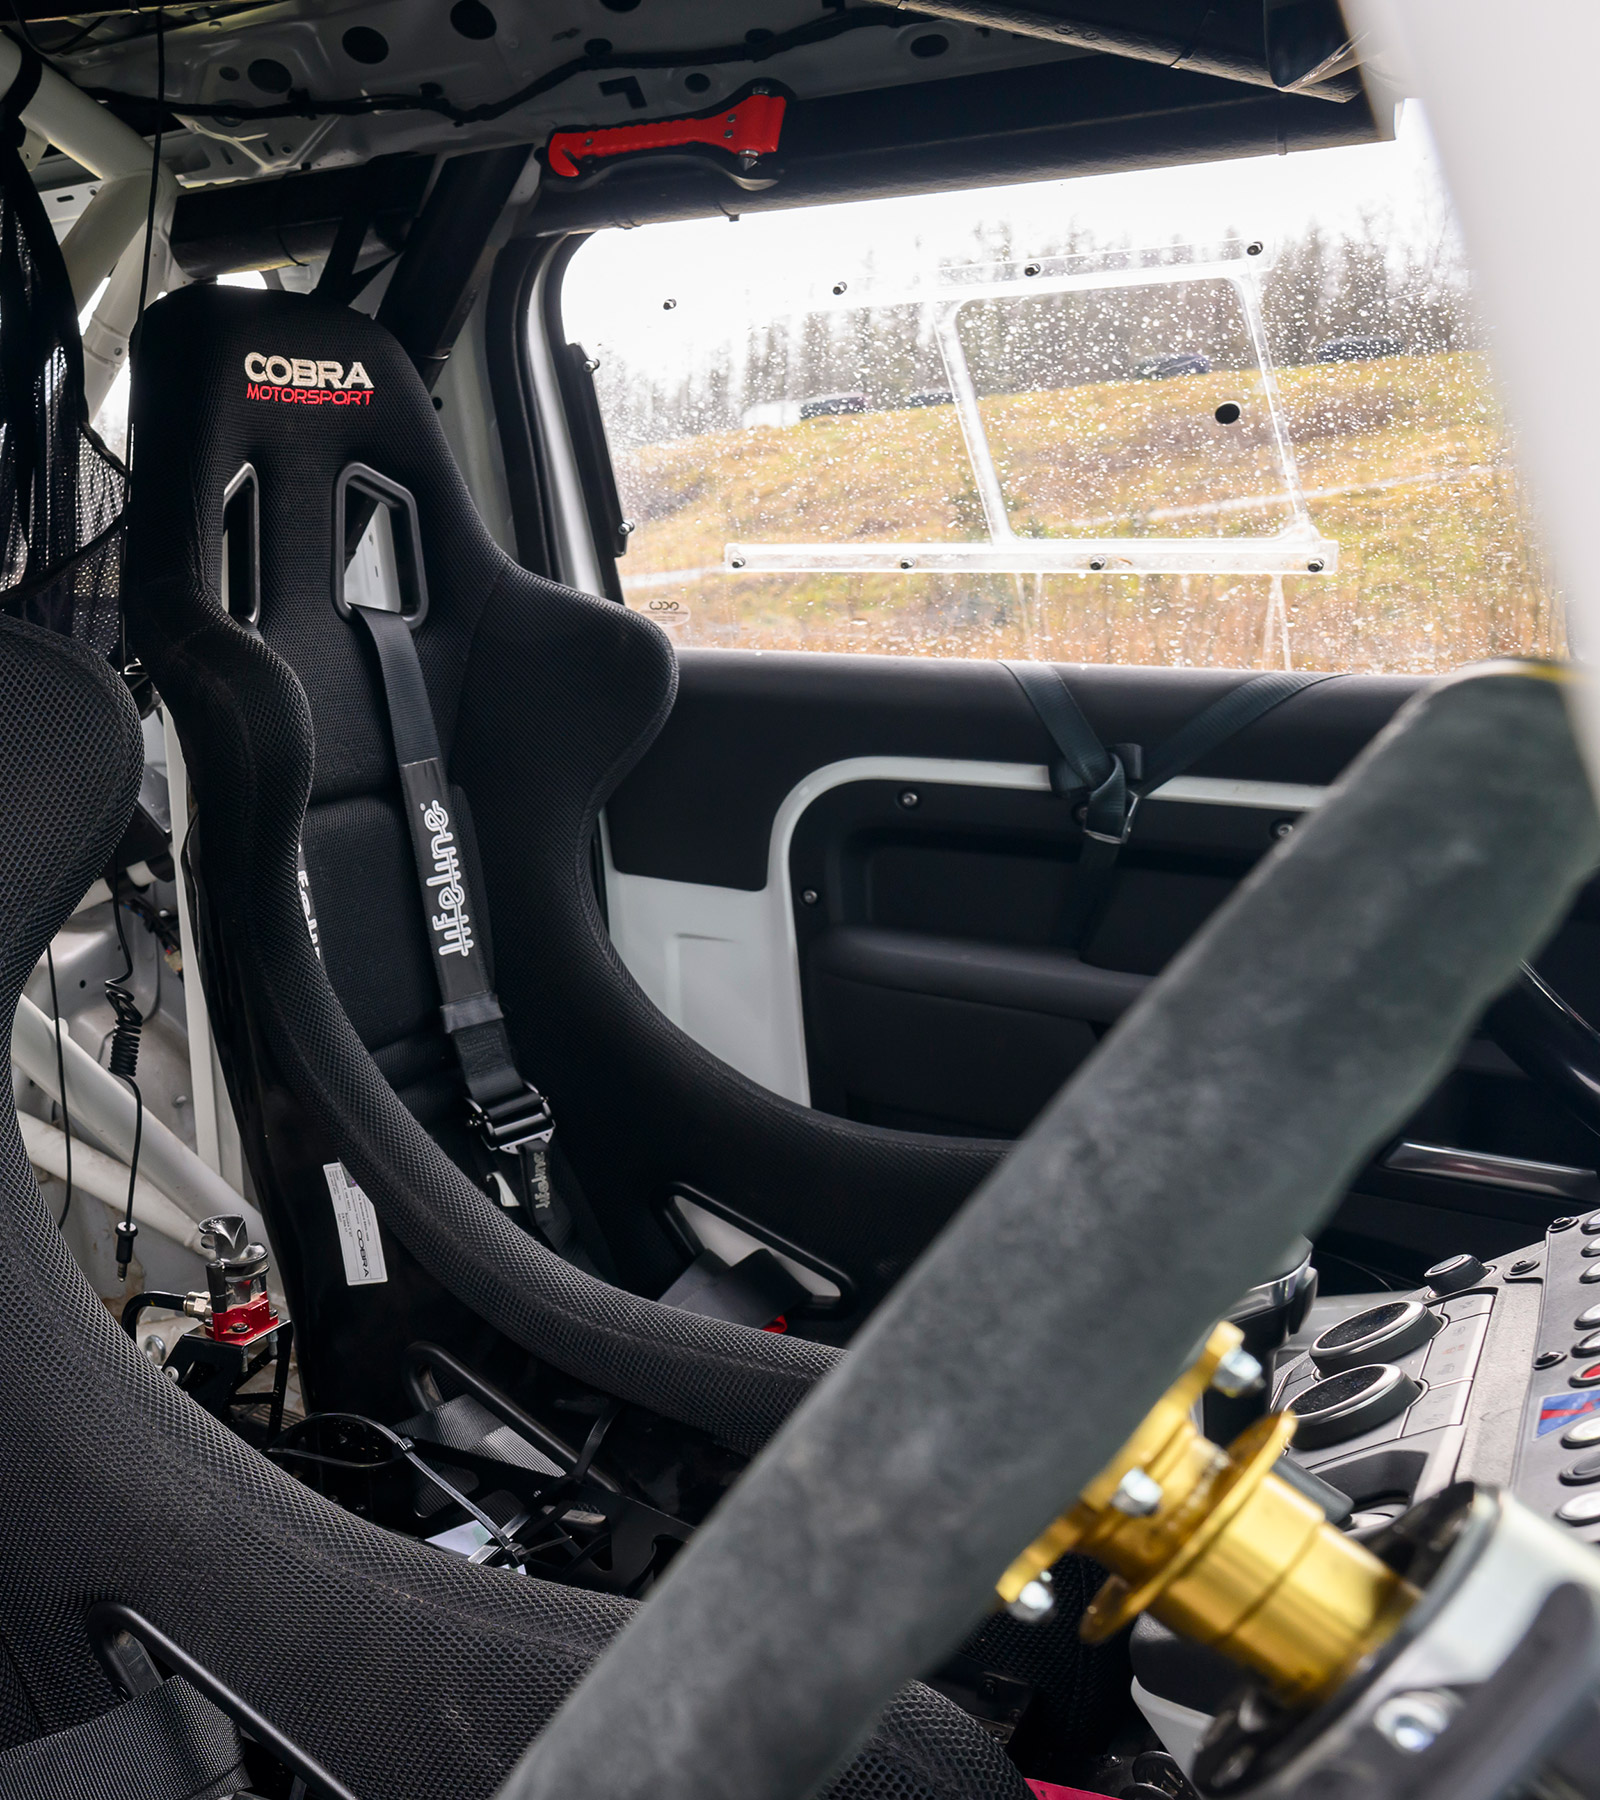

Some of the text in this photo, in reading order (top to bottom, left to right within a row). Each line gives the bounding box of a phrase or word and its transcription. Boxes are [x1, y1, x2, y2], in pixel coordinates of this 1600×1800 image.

[244, 352, 374, 389] COBRA
[246, 383, 374, 406] MOTORSPORT
[356, 1229, 369, 1277] COBRA
